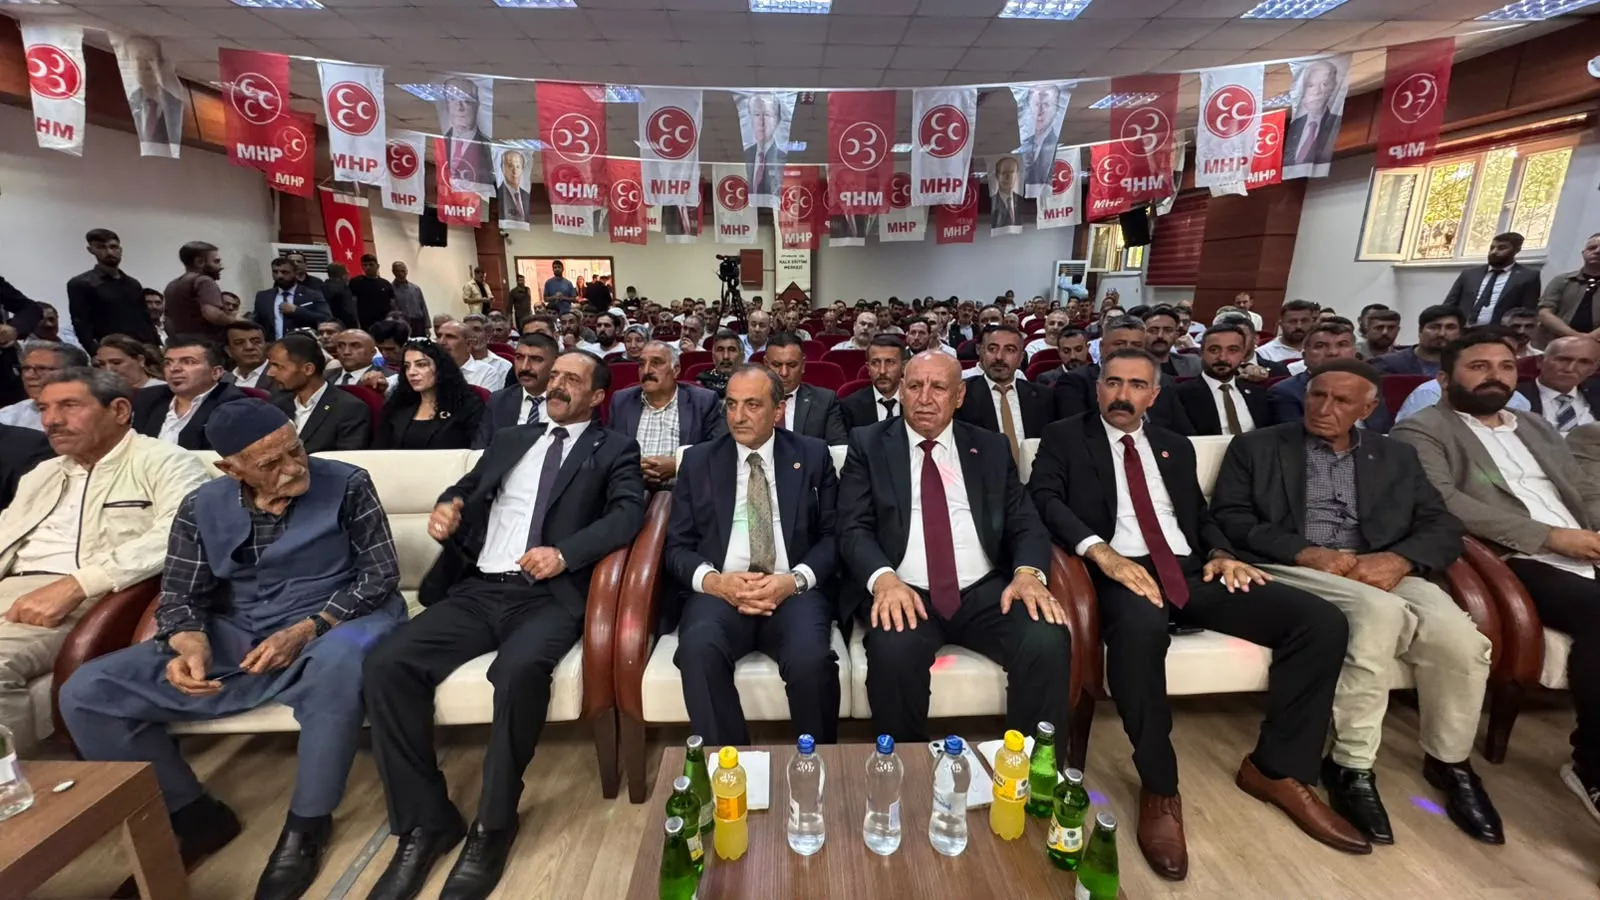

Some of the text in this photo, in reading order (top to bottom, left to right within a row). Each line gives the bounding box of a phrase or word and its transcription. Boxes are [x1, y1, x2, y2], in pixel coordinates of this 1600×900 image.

[236, 142, 283, 163] MHP
[333, 153, 378, 173] MHP
[1204, 156, 1248, 174] MHP
[275, 172, 304, 188] MHP
[1247, 168, 1276, 183] MHP
[651, 179, 690, 195] MHP
[920, 177, 963, 194] MHP
[391, 192, 417, 205] MHP
[1093, 197, 1124, 208] MHP
[444, 204, 476, 217] MHP
[1043, 206, 1073, 220] MHP
[554, 213, 584, 227] MHP
[887, 221, 916, 233] MHP
[614, 226, 642, 237] MHP
[720, 223, 750, 235] MHP
[943, 225, 970, 238] MHP
[785, 231, 812, 243] MHP
